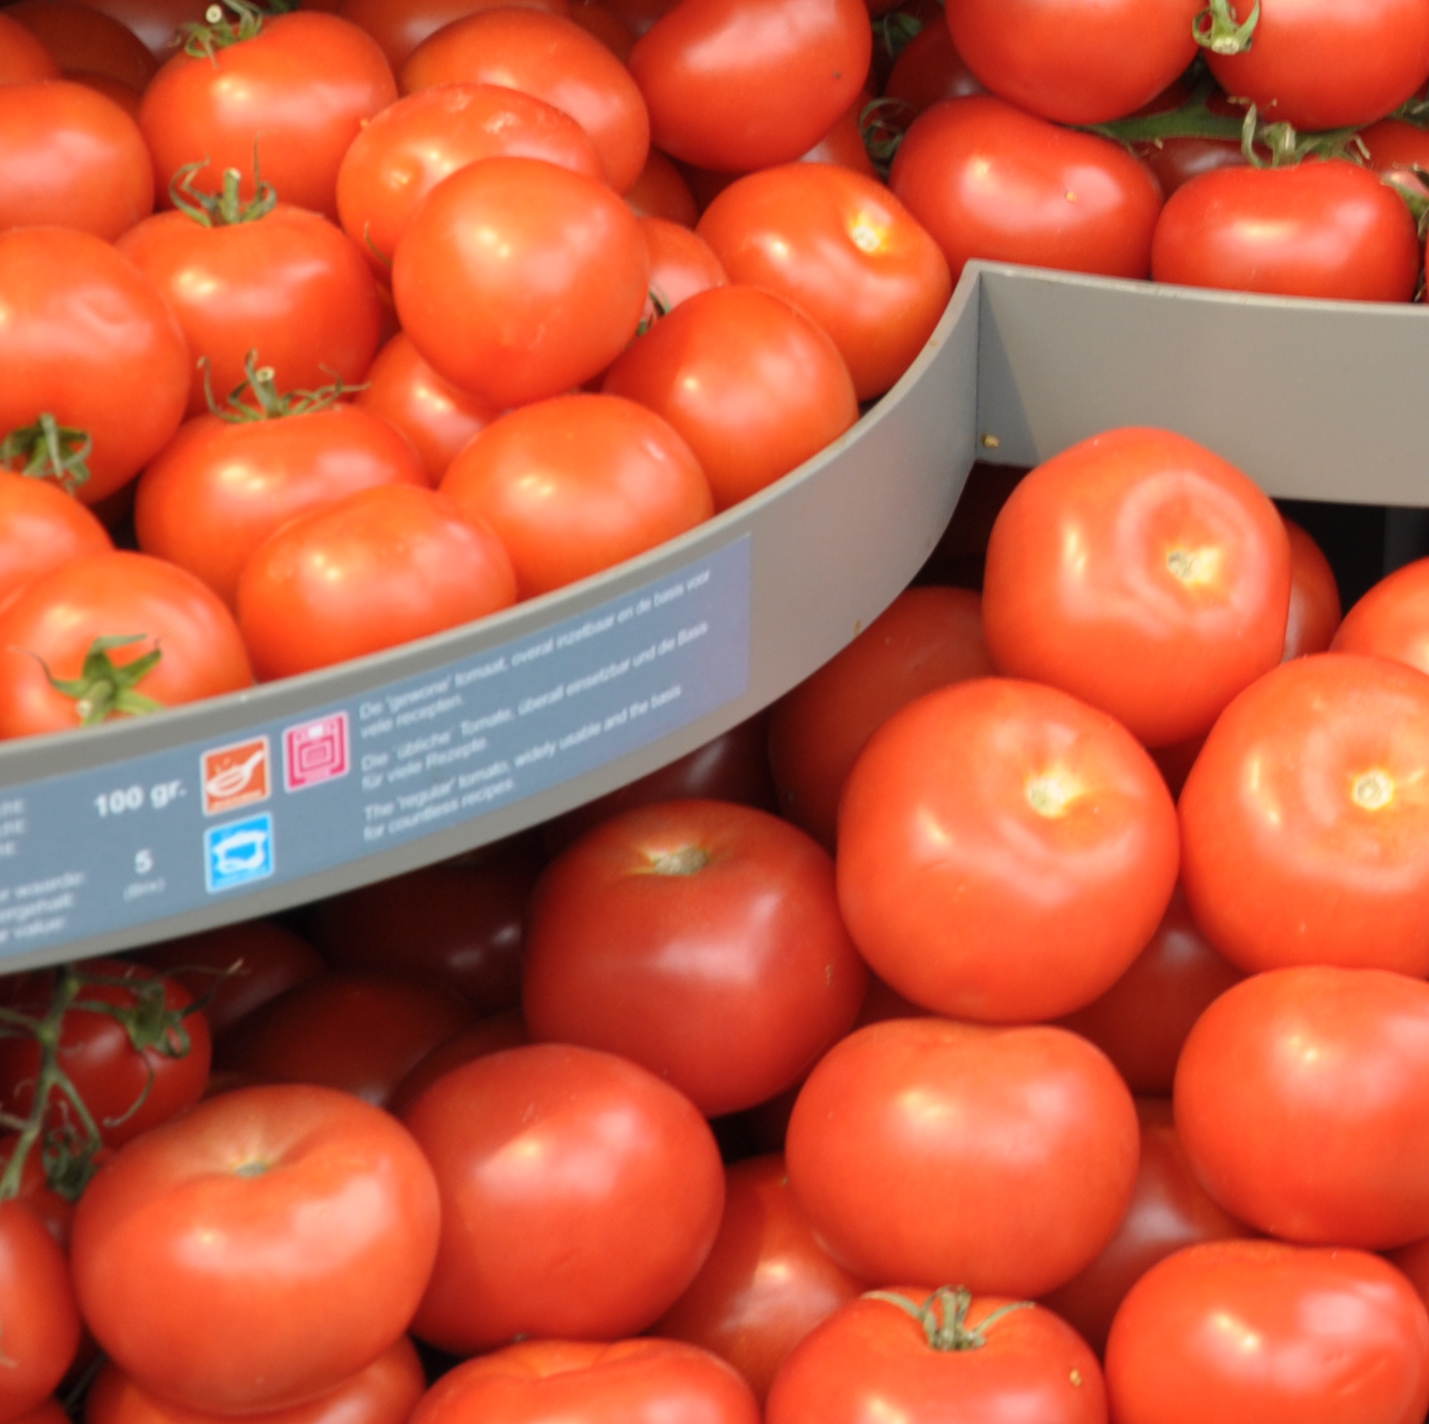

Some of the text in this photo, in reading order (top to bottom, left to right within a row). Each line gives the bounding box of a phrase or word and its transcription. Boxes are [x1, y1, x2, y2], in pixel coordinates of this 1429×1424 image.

[94, 780, 187, 816] 100 gr.
[134, 848, 154, 874] 5
